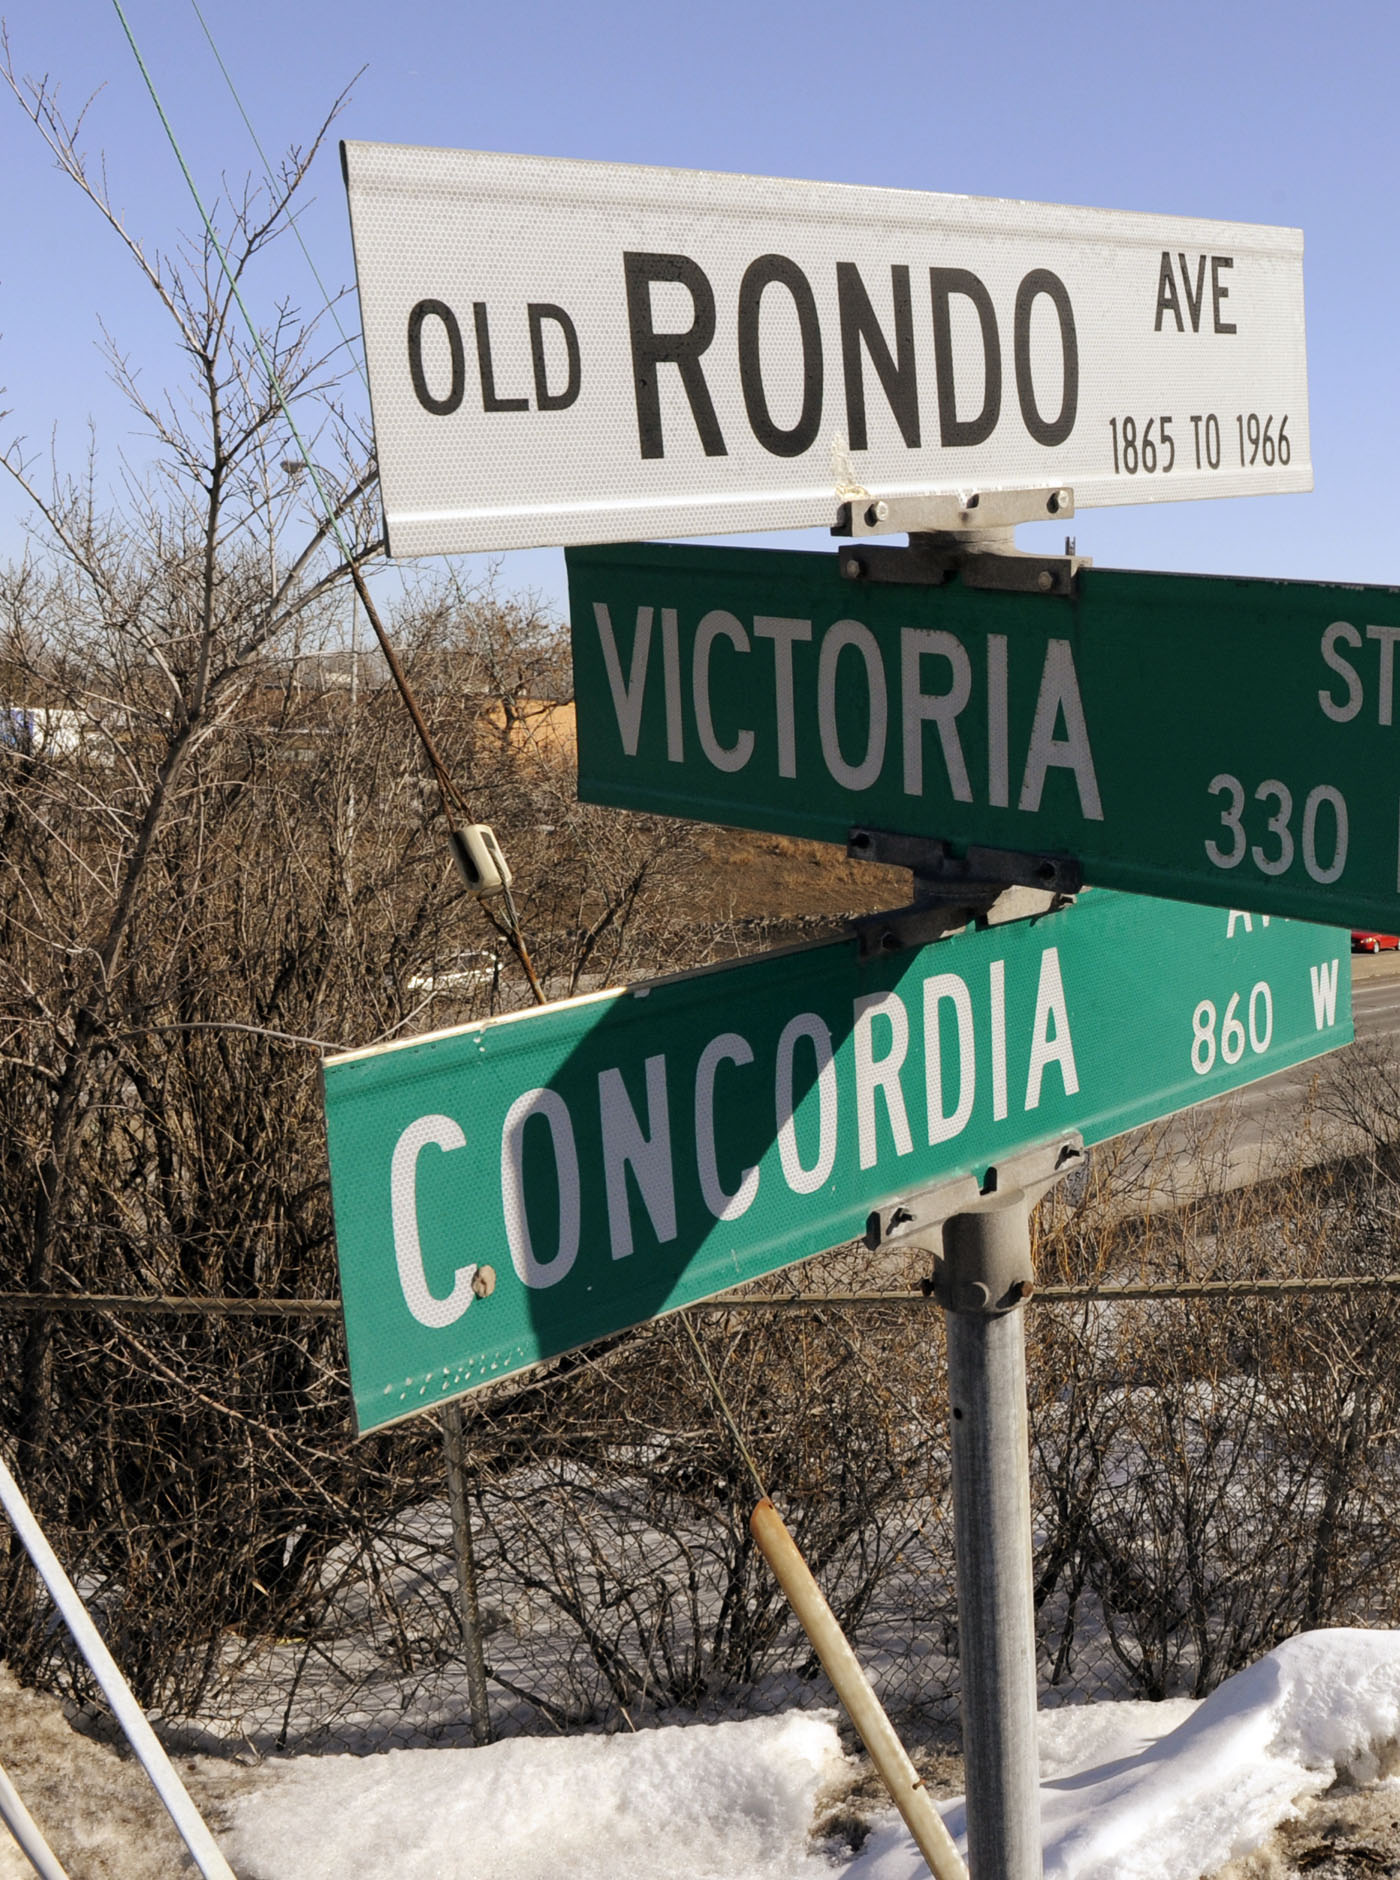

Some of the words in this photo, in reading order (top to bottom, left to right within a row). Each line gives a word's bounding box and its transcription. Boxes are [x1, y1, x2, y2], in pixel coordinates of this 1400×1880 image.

[407, 298, 582, 417] OLD
[622, 250, 1079, 460] RONDO
[1154, 250, 1239, 335] AVE
[1109, 415, 1176, 475] 1865
[1189, 412, 1221, 470] TO
[1236, 412, 1291, 467] 1966
[592, 602, 1105, 821] VICTORIA
[1204, 773, 1349, 885] 330
[1190, 980, 1274, 1076] 860
[1310, 958, 1340, 1031] W
[390, 946, 1081, 1330] CONCORDIA
